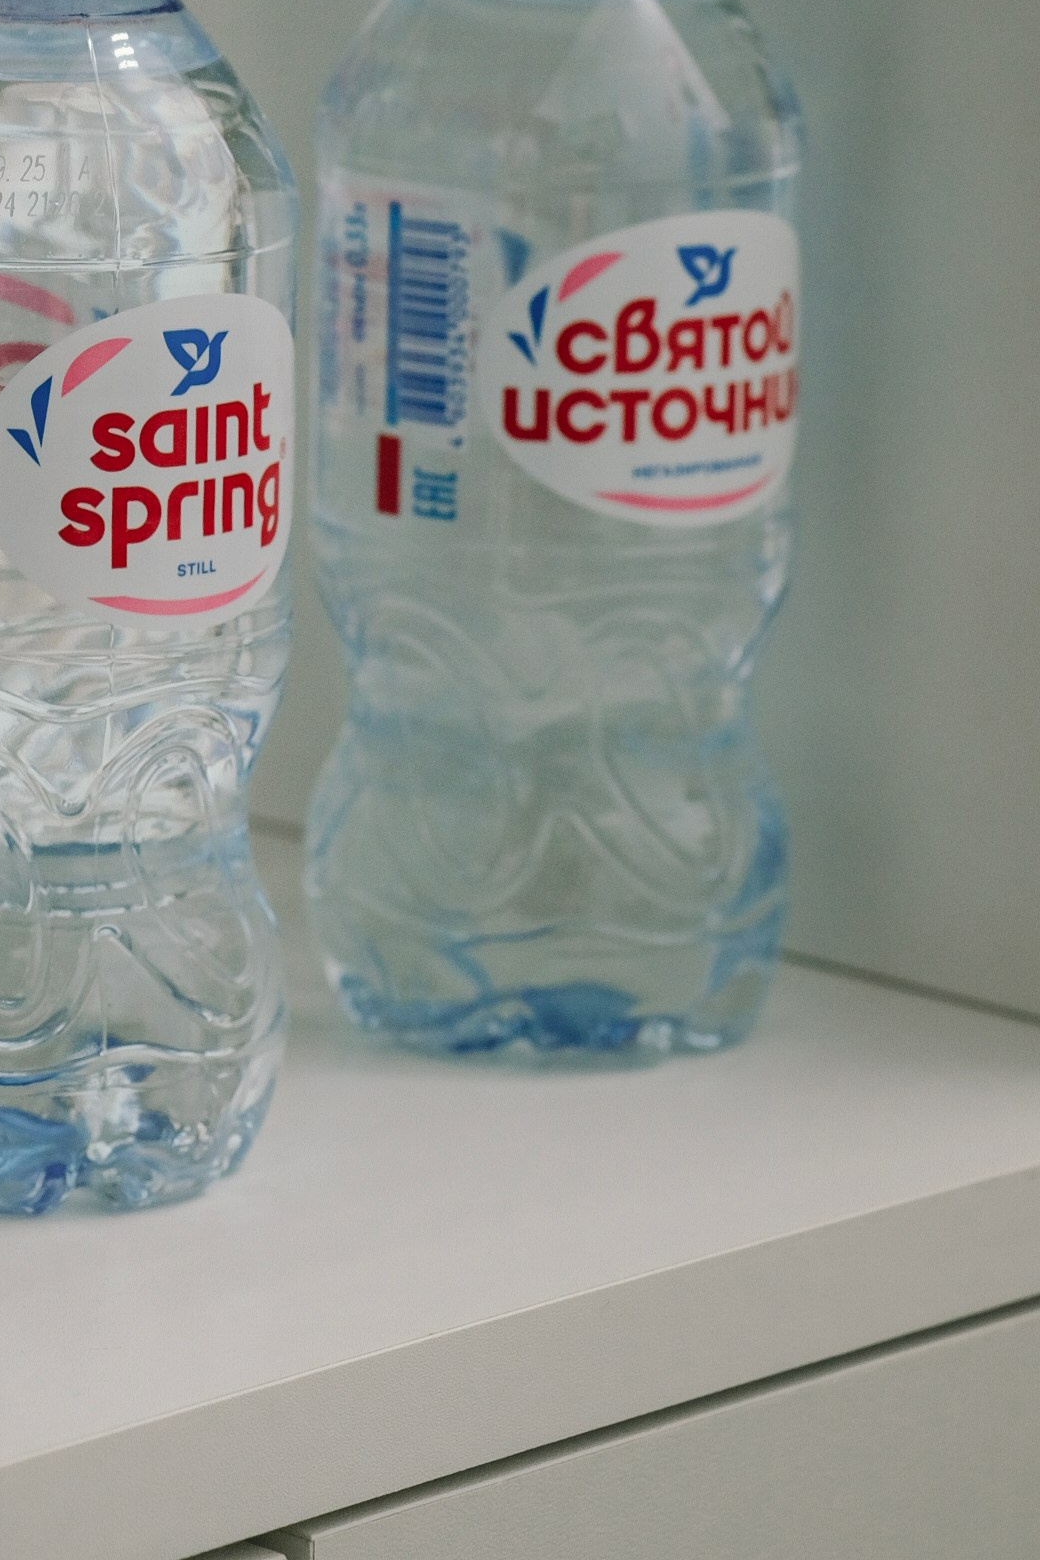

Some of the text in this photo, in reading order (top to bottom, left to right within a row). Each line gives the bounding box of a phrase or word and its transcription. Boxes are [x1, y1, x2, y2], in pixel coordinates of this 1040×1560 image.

[89, 381, 271, 474] saint
[57, 461, 280, 570] spring
[177, 559, 217, 578] STILL
